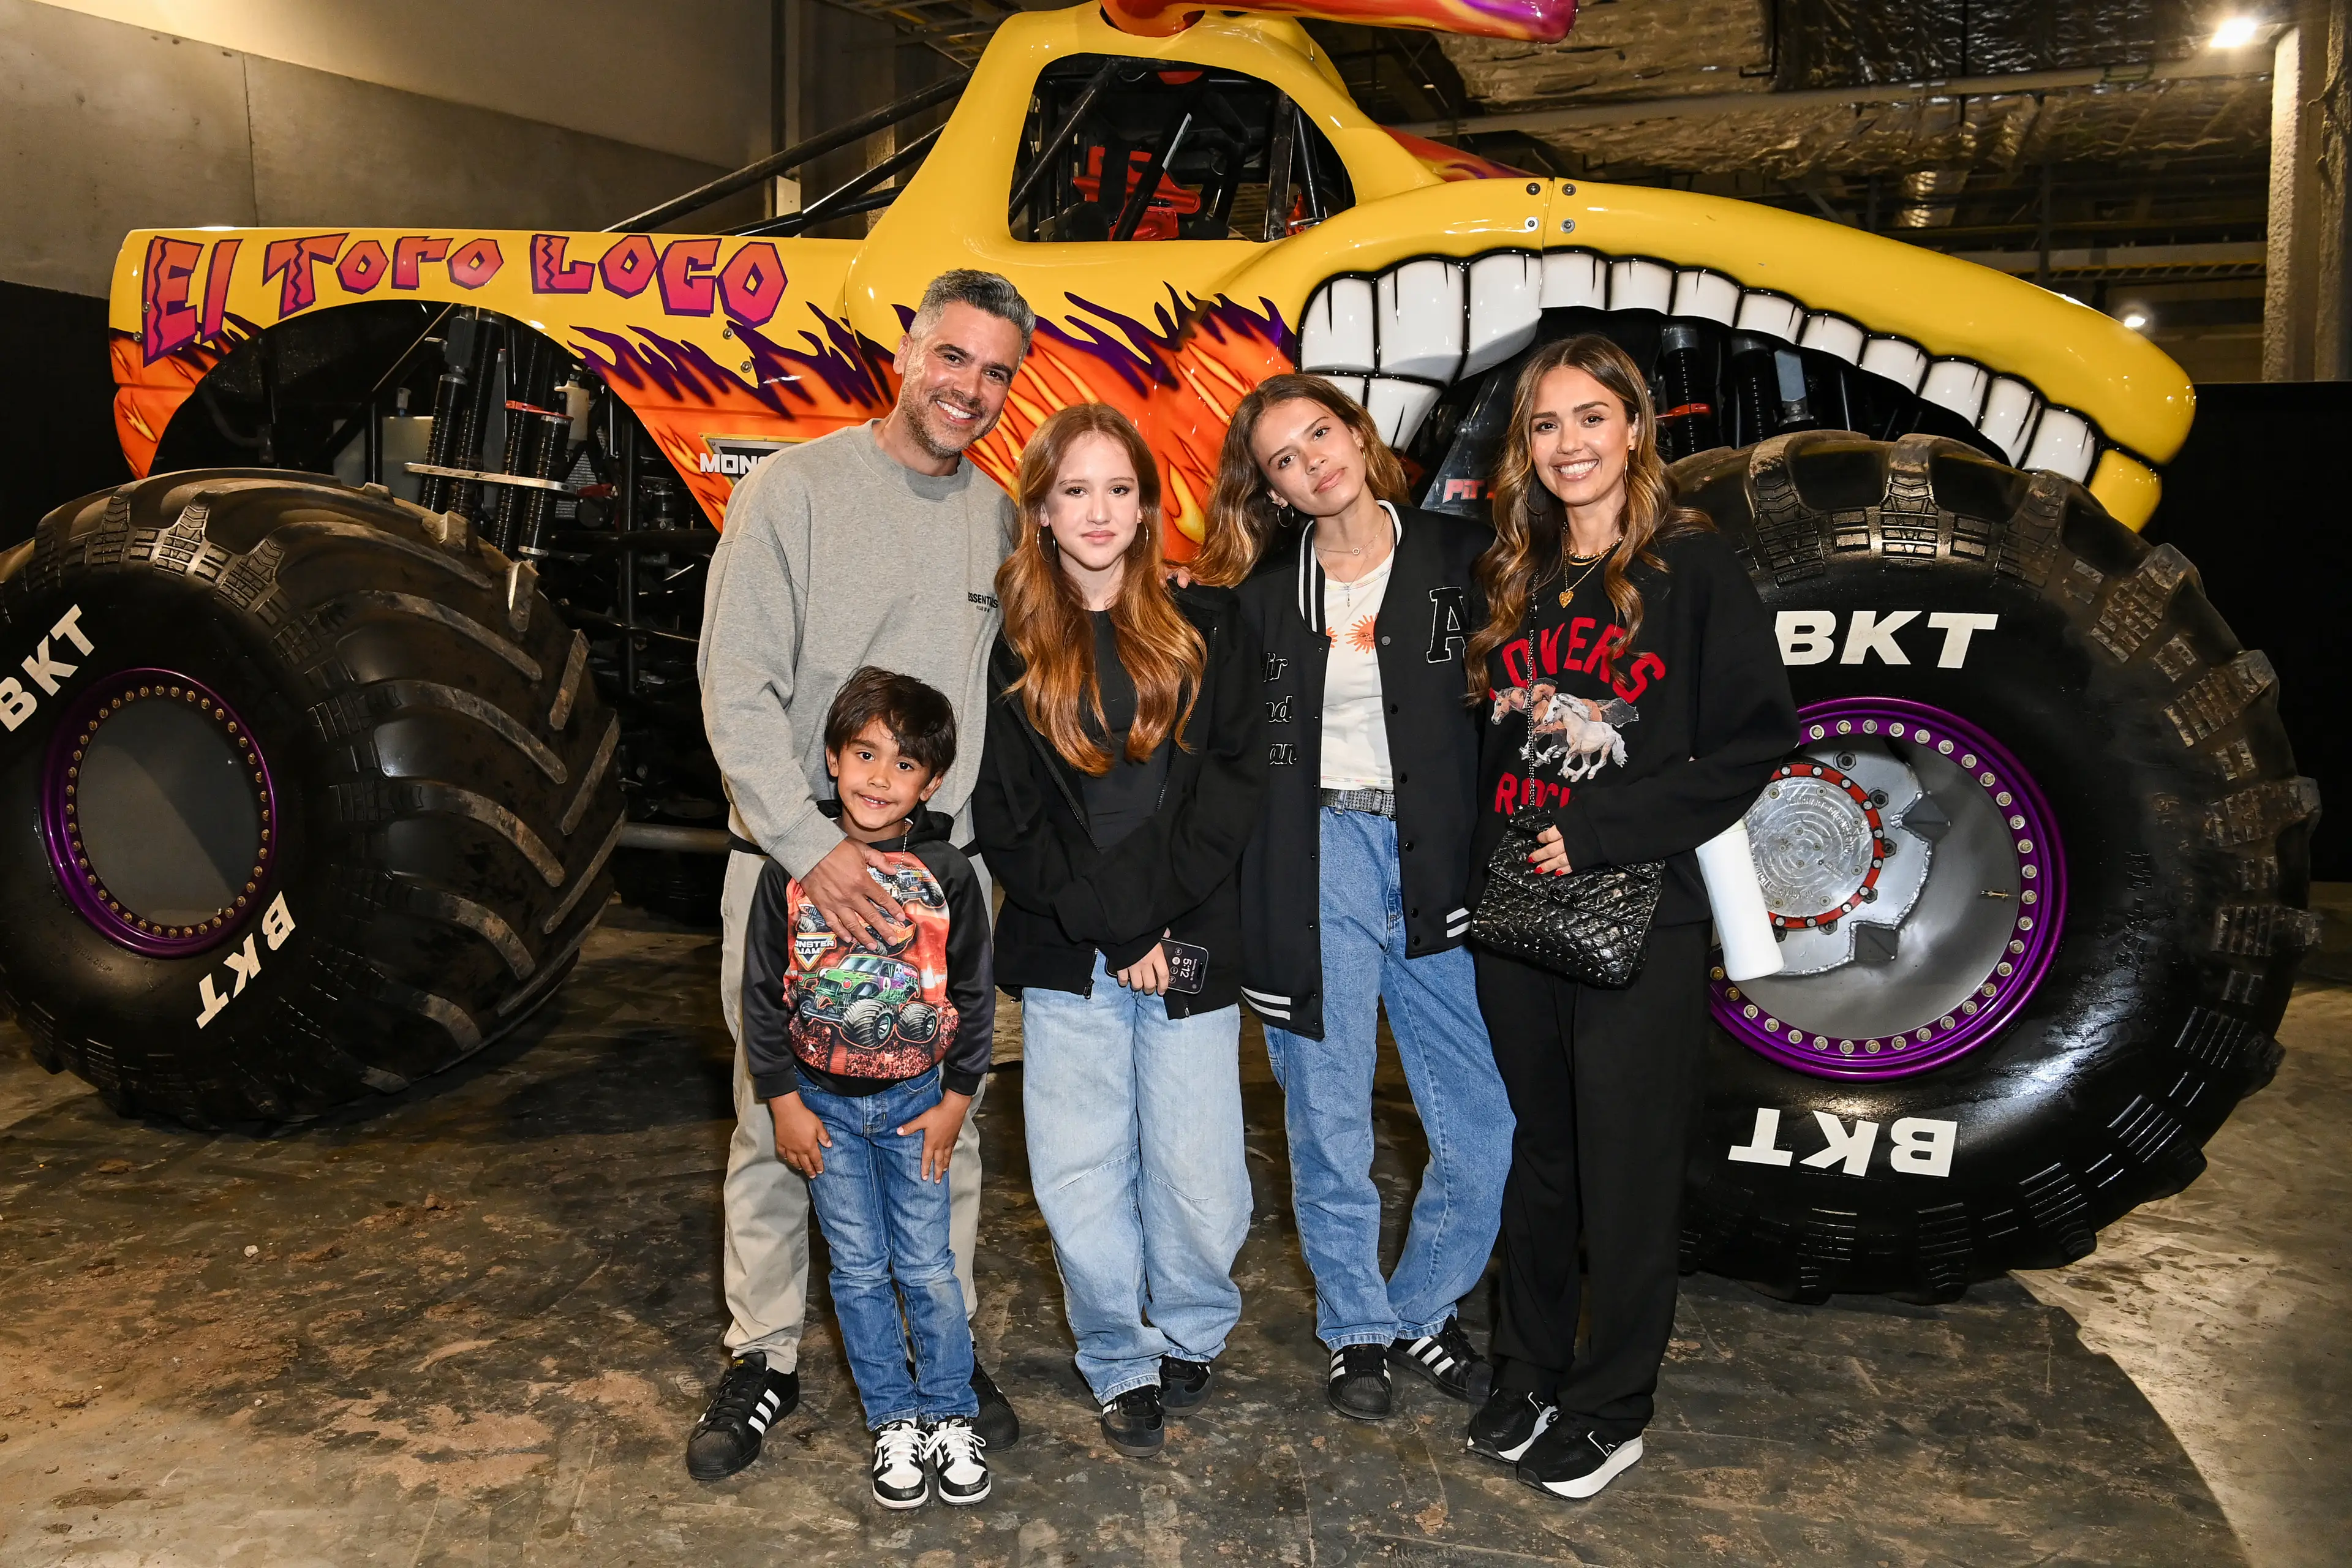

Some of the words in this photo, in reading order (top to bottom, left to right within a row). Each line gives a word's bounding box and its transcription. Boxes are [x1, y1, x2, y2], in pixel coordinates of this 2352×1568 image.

[142, 236, 243, 367] El
[699, 453, 768, 474] MON
[1426, 586, 1466, 663] A
[1489, 617, 1666, 704] OVERS
[1775, 610, 1998, 668] BKT
[0, 603, 94, 731] BKT
[195, 891, 296, 1029] BKT
[1180, 958, 1193, 978] 5:12
[1728, 1108, 1957, 1177] BKT
